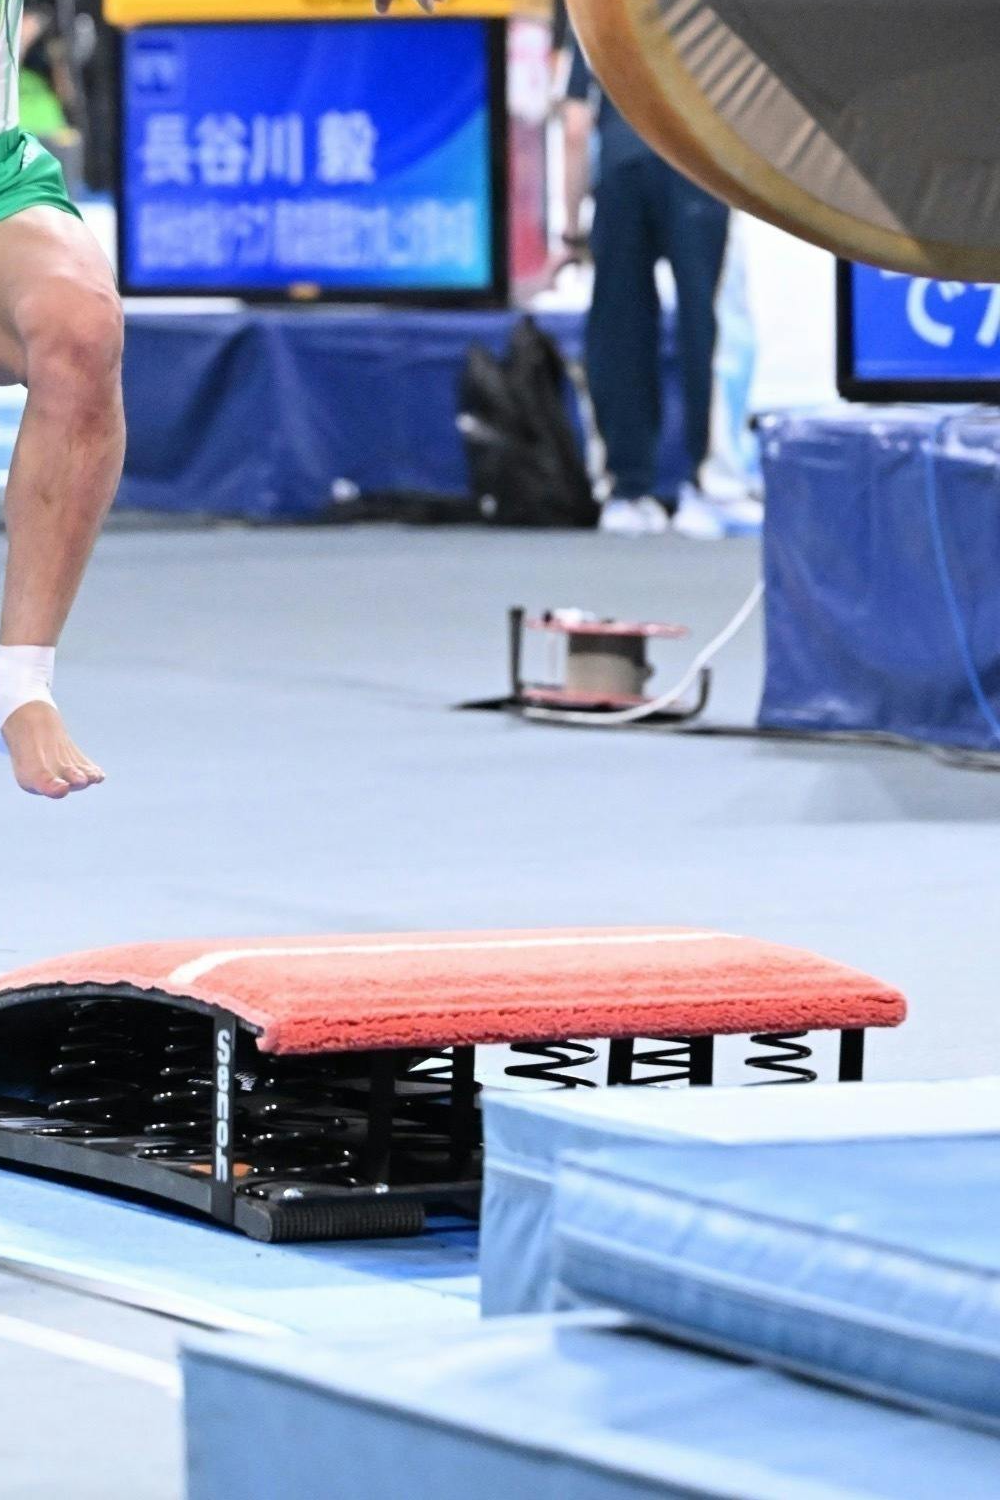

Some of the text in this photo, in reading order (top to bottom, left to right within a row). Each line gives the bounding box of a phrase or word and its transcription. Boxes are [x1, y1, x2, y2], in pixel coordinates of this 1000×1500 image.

[141, 112, 304, 187] 長谷川
[216, 1028, 231, 1183] Senoh
